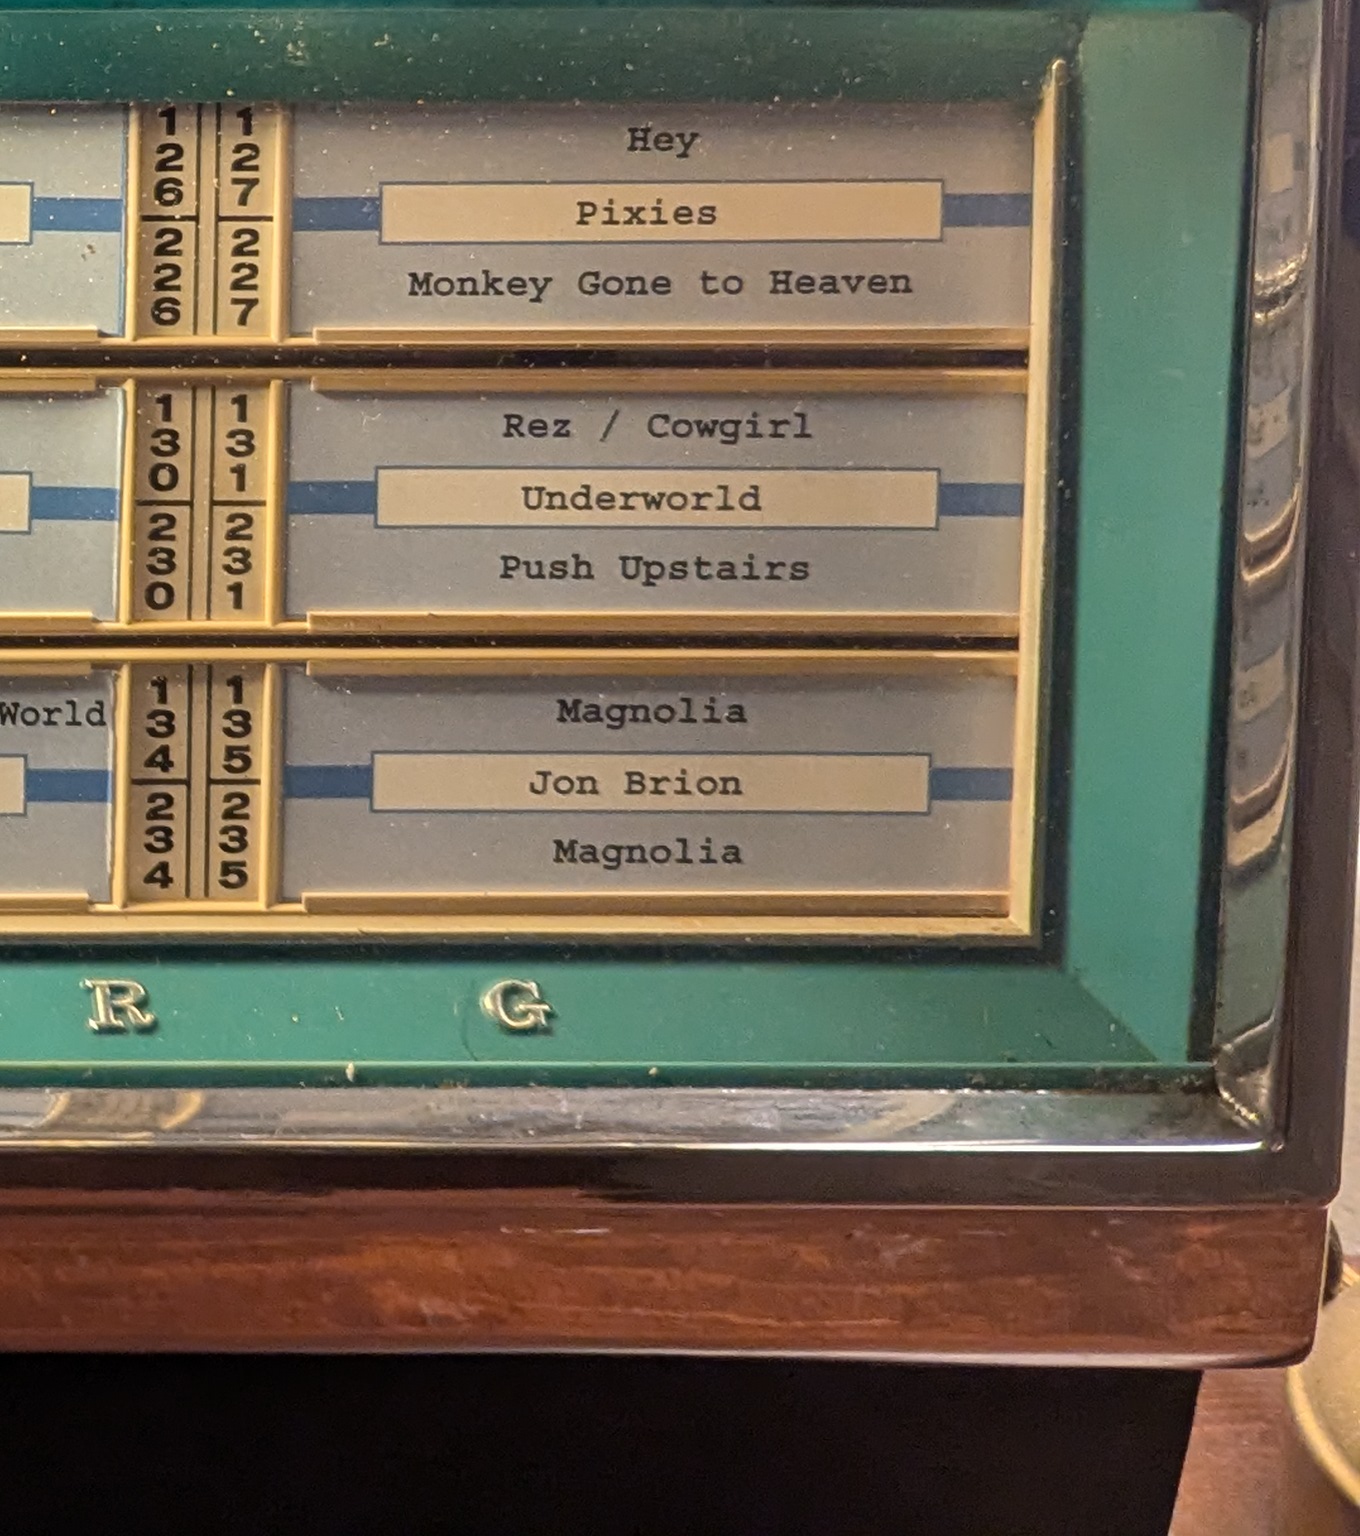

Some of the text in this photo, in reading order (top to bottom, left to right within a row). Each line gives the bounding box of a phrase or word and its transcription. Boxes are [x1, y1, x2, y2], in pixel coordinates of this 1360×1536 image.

[626, 127, 700, 159] Hey
[576, 201, 717, 226] Pixies
[407, 269, 913, 304] Monkey Gone to Heaven
[502, 409, 813, 446] Rez / Cowgirl
[521, 484, 762, 512] Underworld
[499, 553, 810, 587] Push Upstairs
[556, 697, 748, 730] Magnolia
[529, 768, 743, 796] Jon Brion
[552, 837, 743, 871] Magnolia
